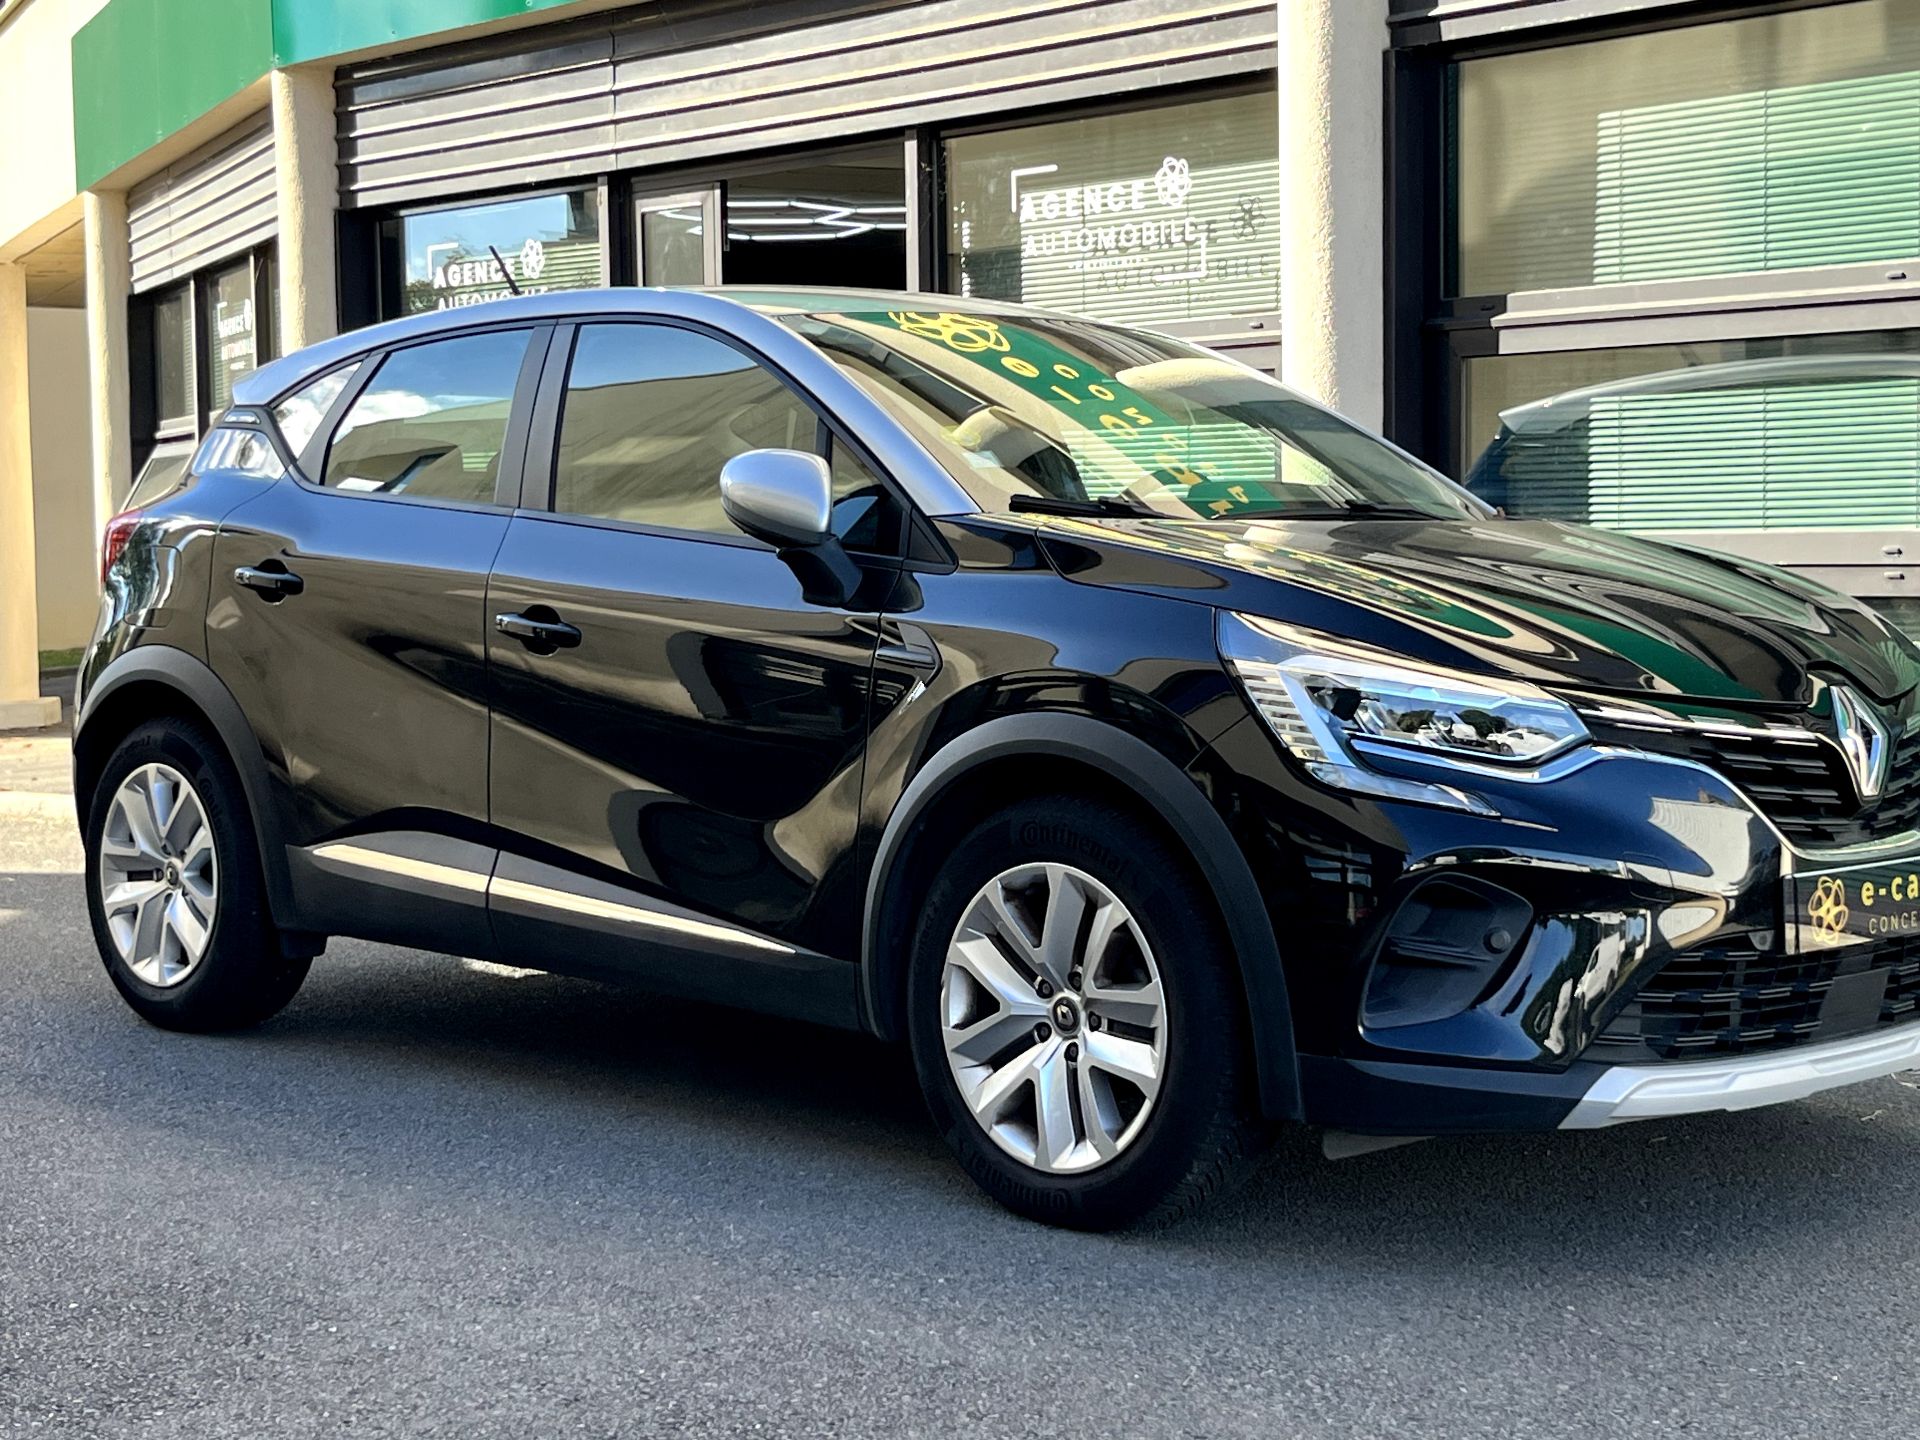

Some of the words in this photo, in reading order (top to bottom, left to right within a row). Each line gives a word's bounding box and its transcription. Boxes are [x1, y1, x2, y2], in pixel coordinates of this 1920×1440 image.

[1020, 179, 1147, 223] AGENCE
[1022, 217, 1198, 258] AUTOMOBILE
[433, 257, 516, 289] AGENCE
[1868, 911, 1918, 934] CONCE
